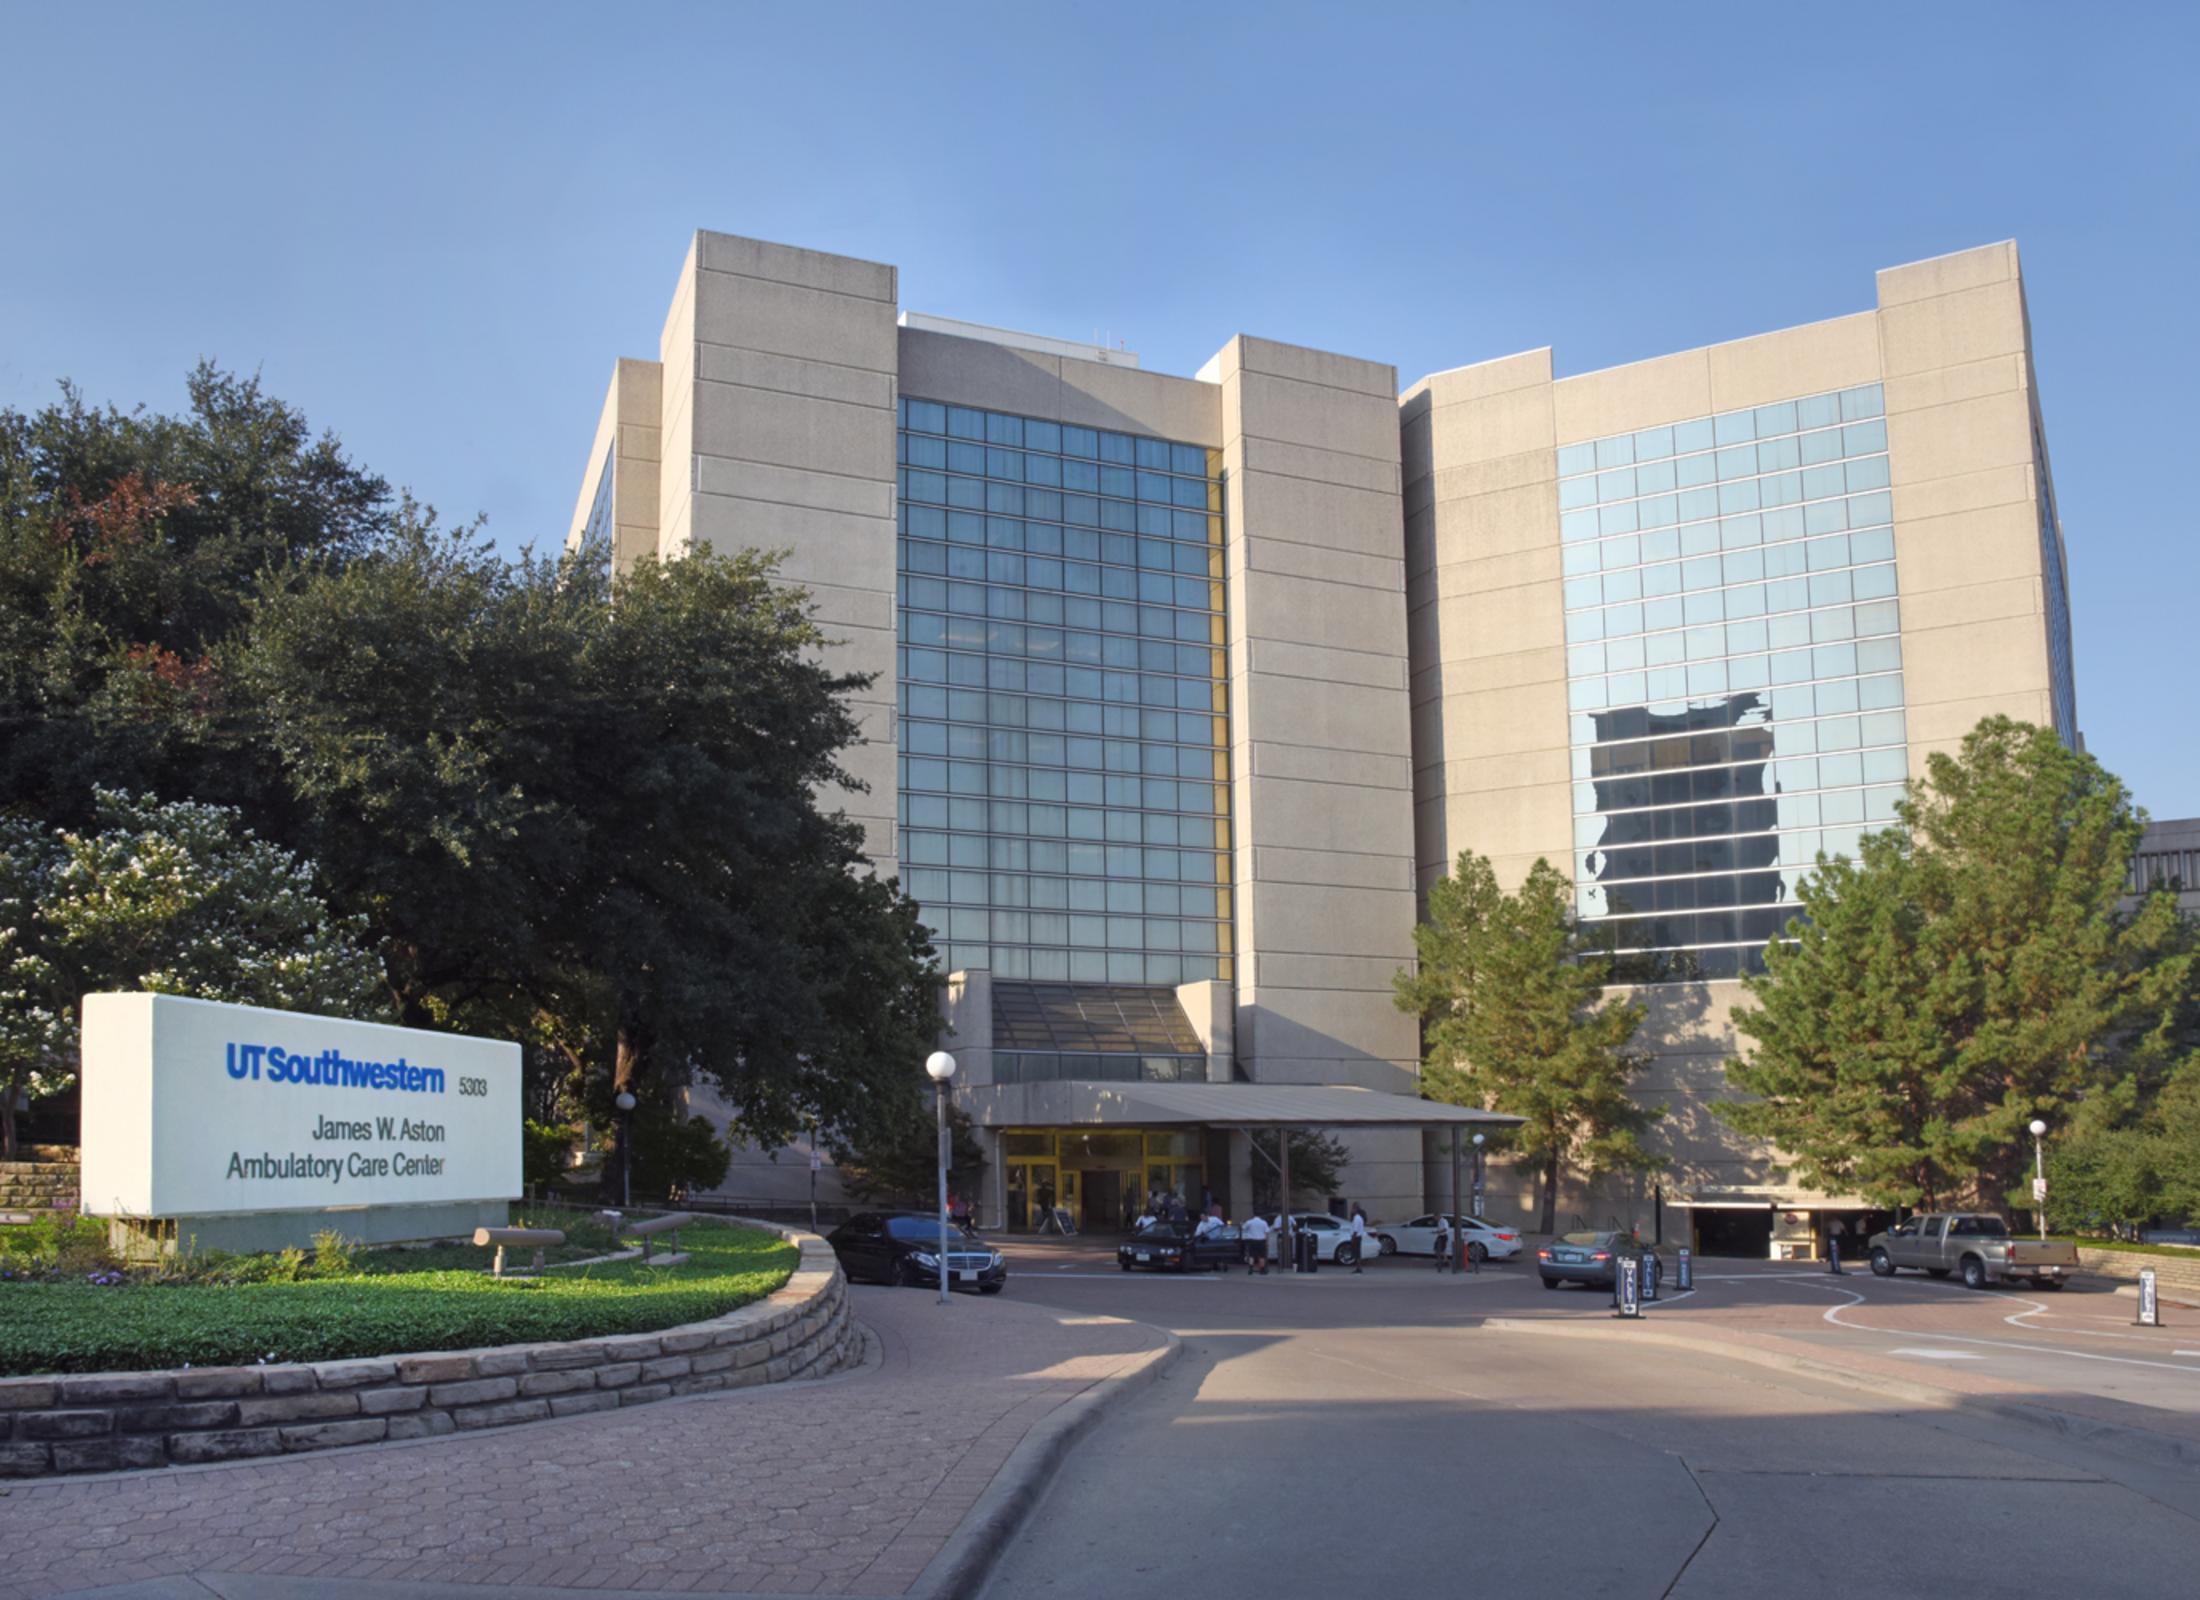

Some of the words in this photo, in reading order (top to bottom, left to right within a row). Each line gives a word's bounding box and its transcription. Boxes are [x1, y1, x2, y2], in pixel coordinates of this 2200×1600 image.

[459, 1076, 488, 1097] 5303
[312, 1114, 373, 1141] James
[375, 1116, 397, 1141] W.
[399, 1117, 445, 1142] Aston
[226, 1151, 344, 1184] Ambulatory
[346, 1152, 389, 1178] Care
[392, 1151, 445, 1176] Center
